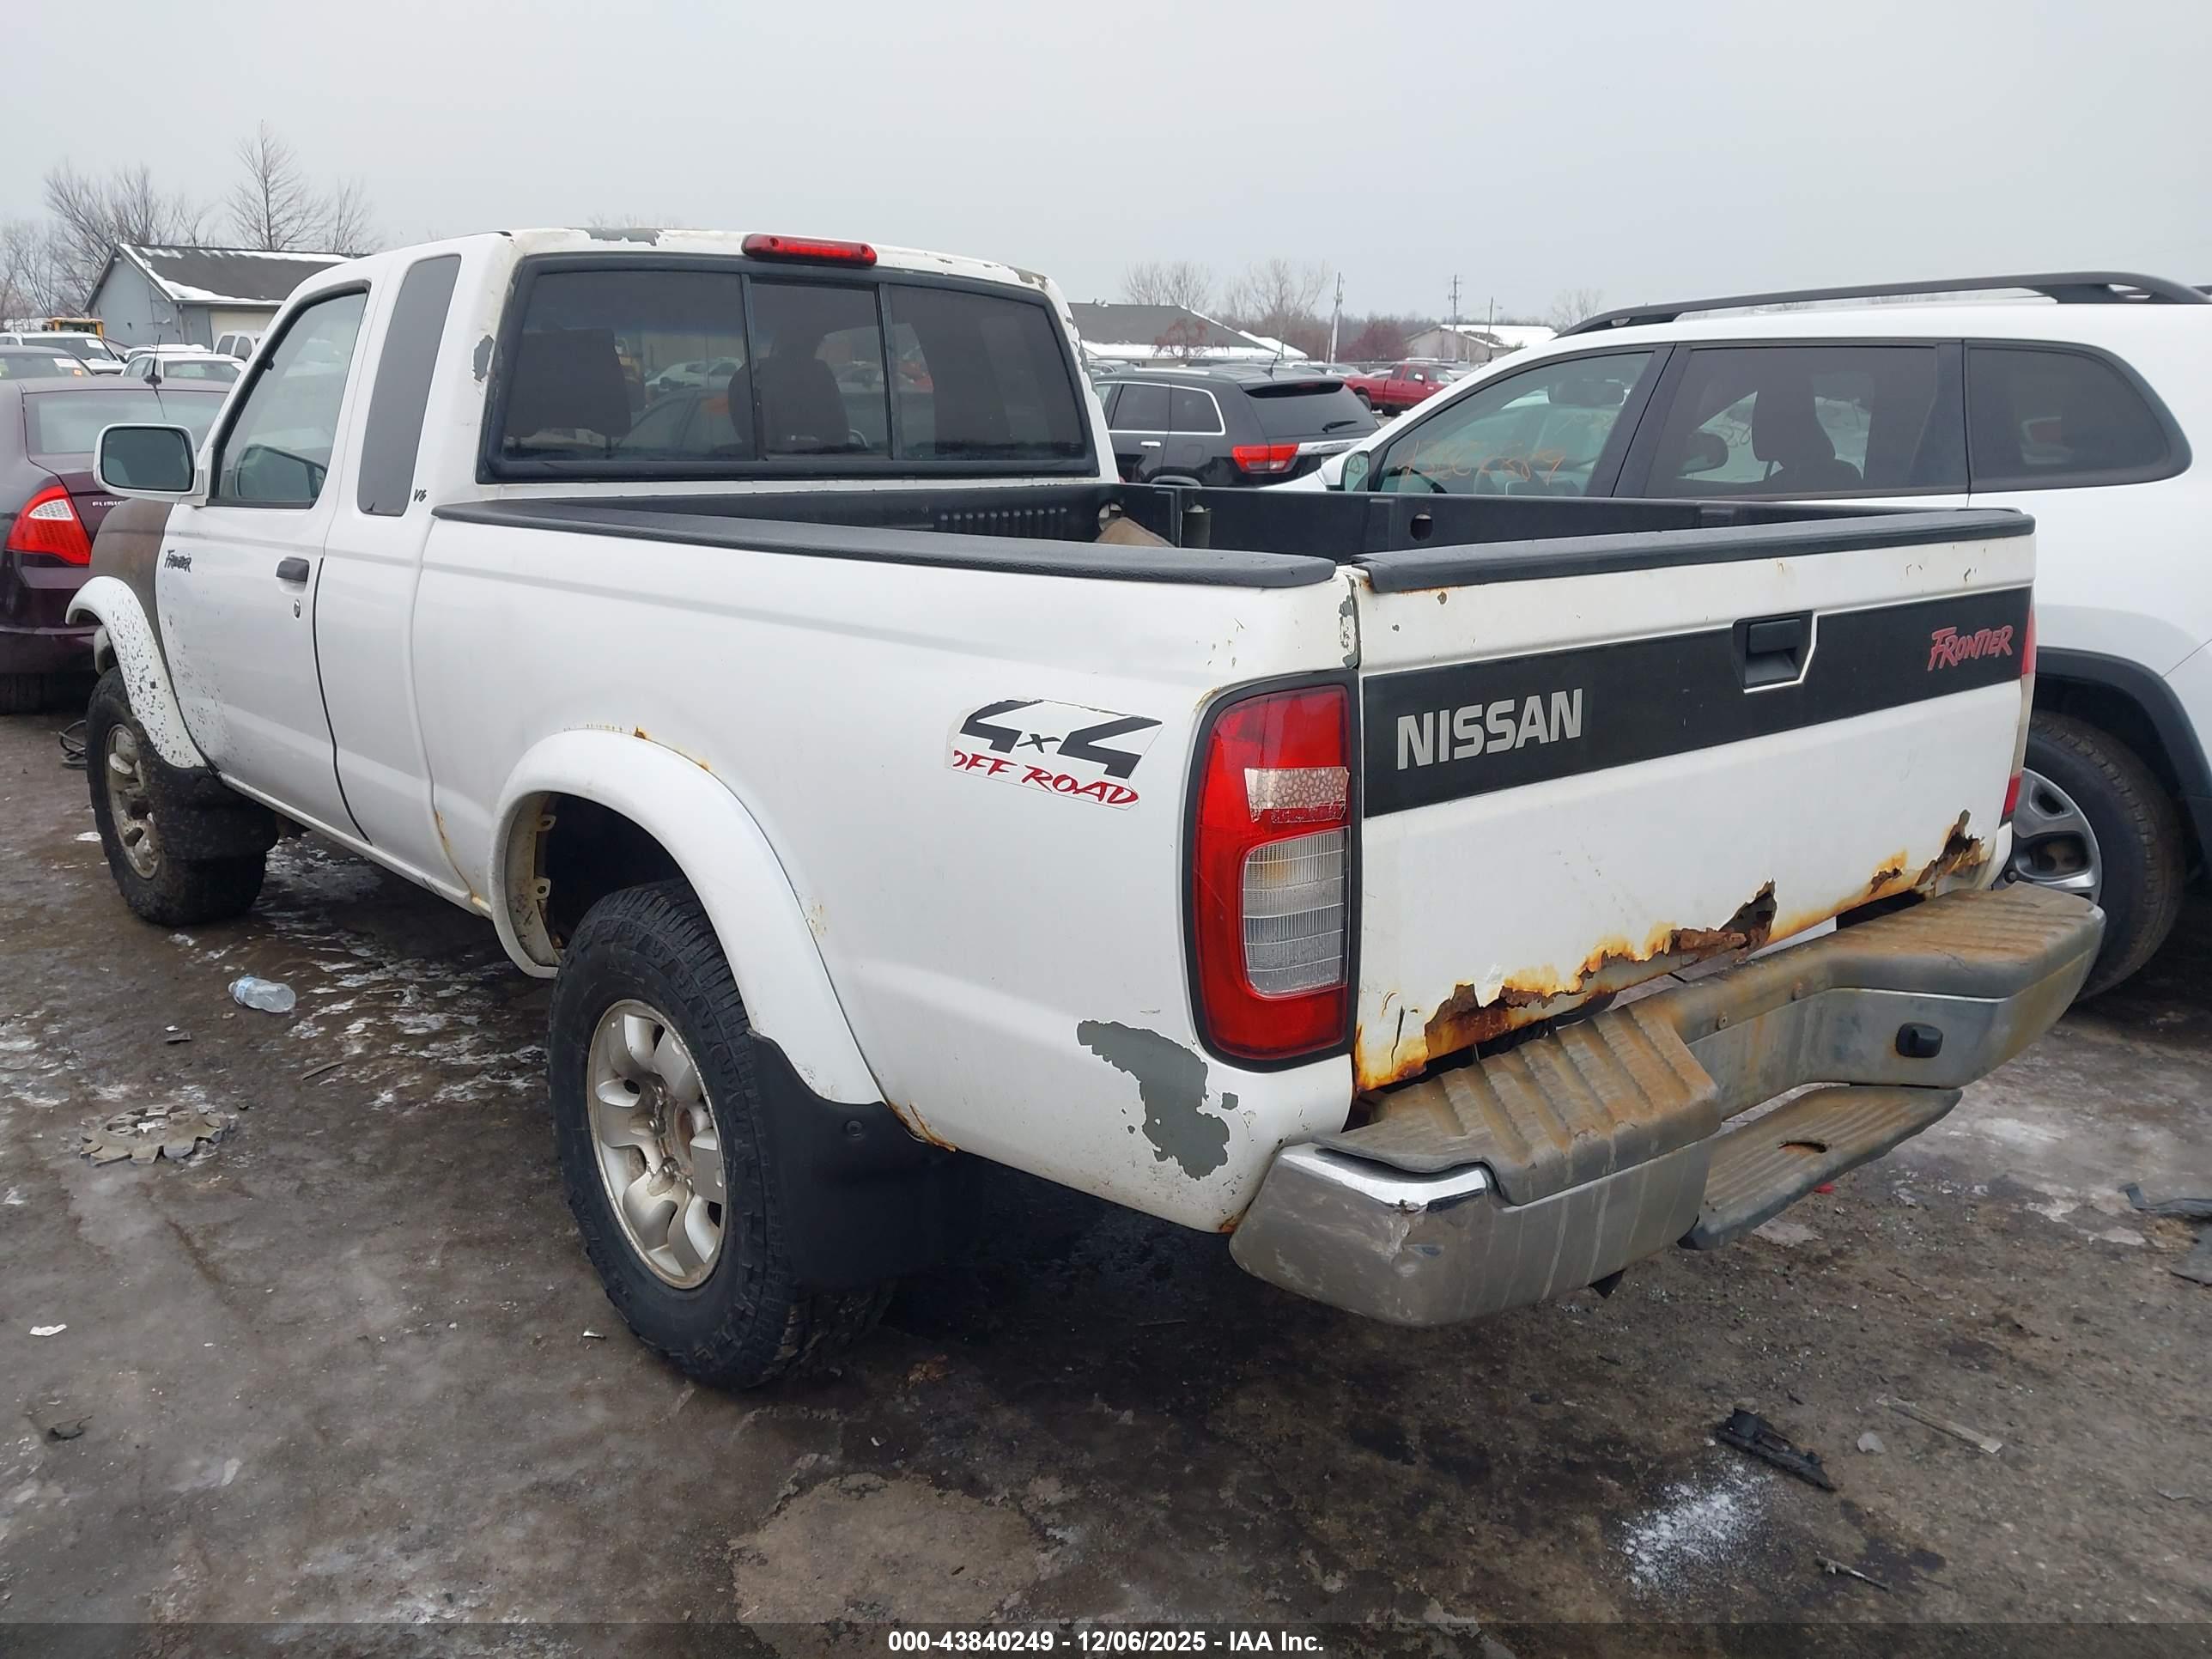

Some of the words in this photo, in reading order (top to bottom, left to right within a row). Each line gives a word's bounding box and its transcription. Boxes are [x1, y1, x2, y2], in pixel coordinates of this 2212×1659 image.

[413, 489, 427, 502] V6
[1927, 625, 2014, 672] FRONTIER
[1397, 688, 1583, 770] NISSAN
[1020, 765, 1140, 805] ROAD
